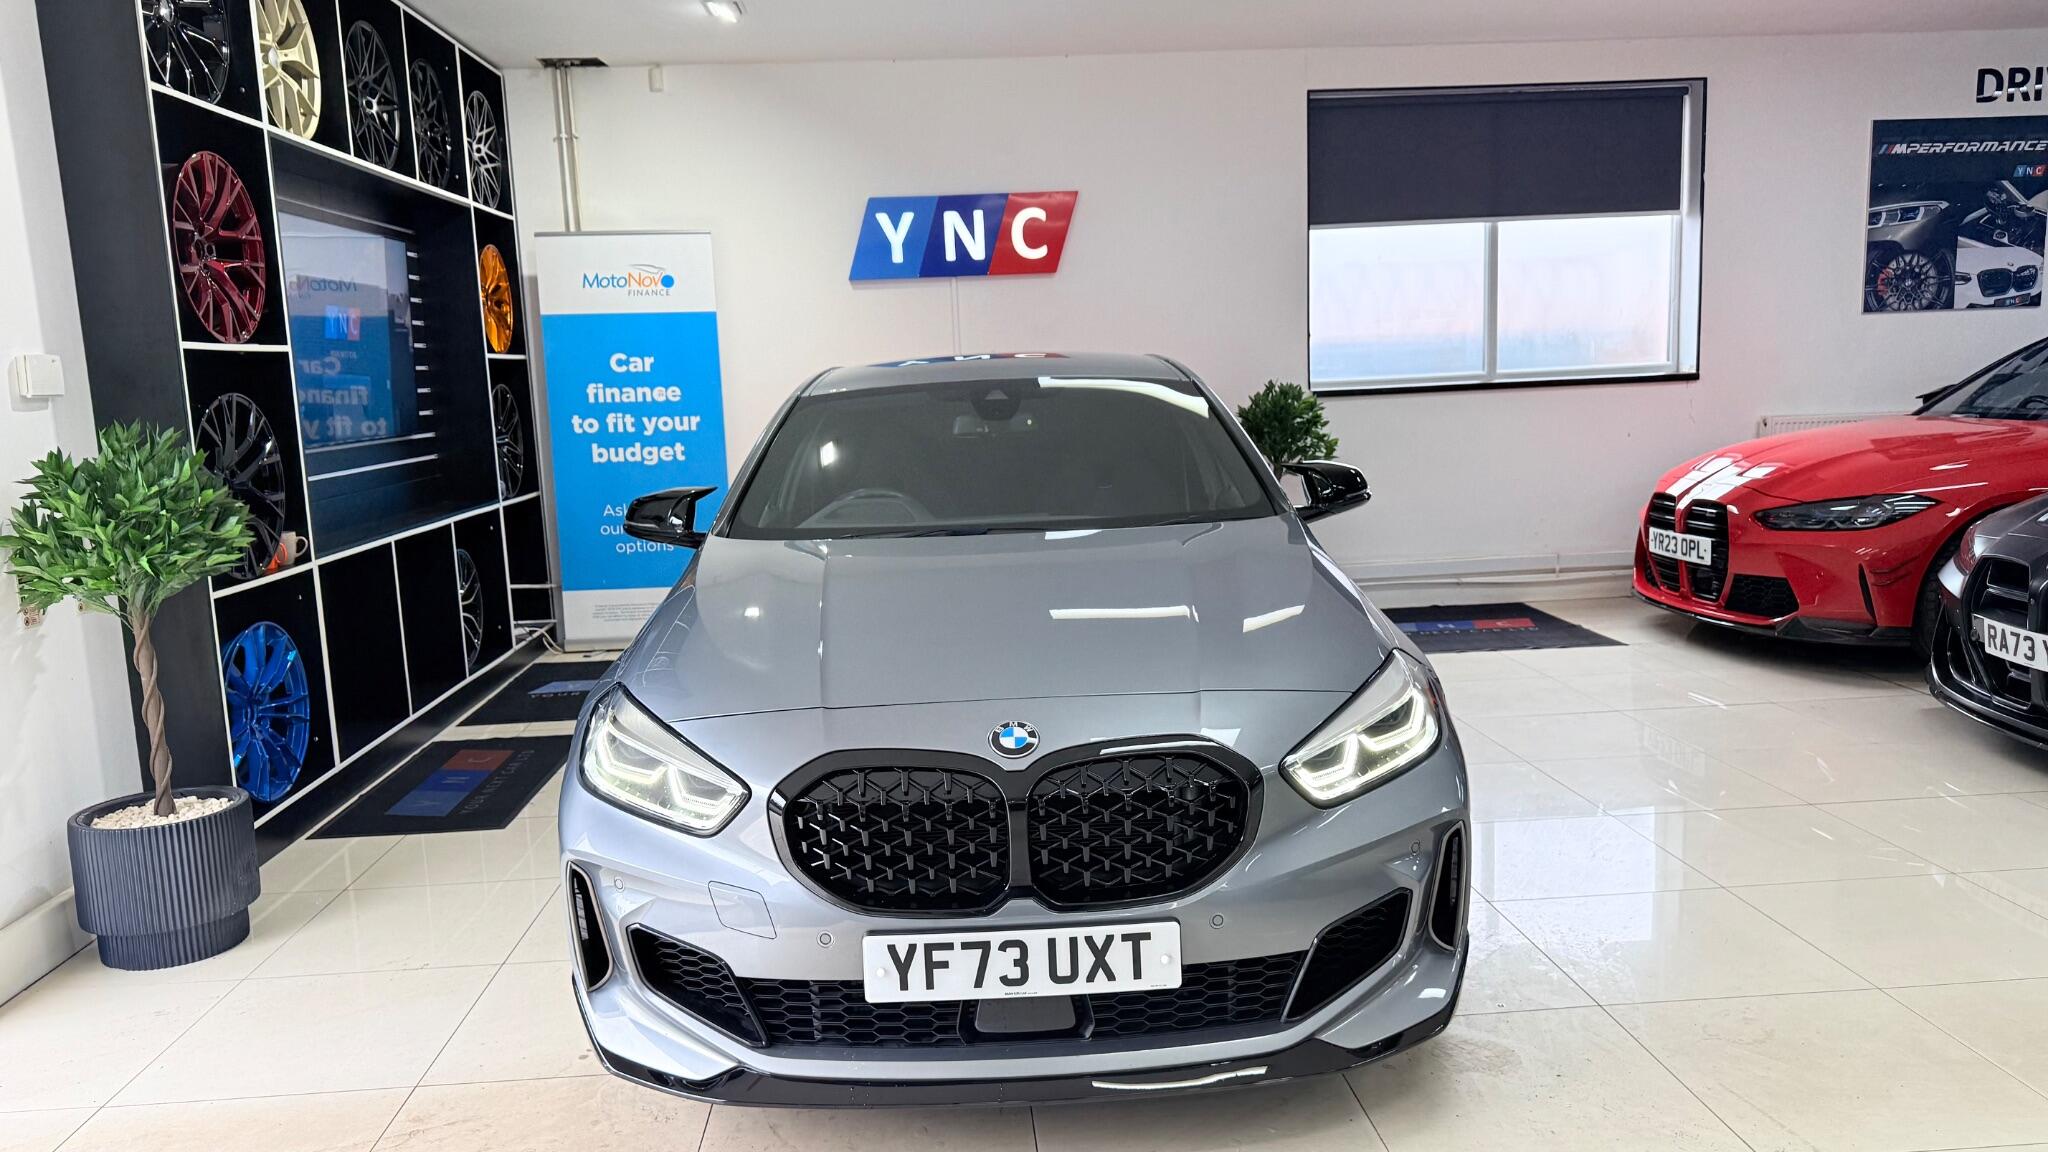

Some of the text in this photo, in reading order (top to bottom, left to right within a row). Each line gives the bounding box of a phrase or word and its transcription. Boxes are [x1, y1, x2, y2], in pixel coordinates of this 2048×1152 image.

[1976, 67, 2048, 103] DRI
[2017, 165, 2043, 175] YNC
[875, 207, 1048, 263] YNC
[627, 289, 671, 297] FINANCE
[609, 352, 655, 373] Car
[586, 383, 682, 403] finance
[571, 412, 701, 436] to fit your
[591, 442, 686, 466] budget
[616, 540, 675, 555] options
[1653, 531, 1705, 560] YR23 OPL
[1988, 623, 2036, 661] RA73
[887, 932, 1151, 991] YF73 UXT
